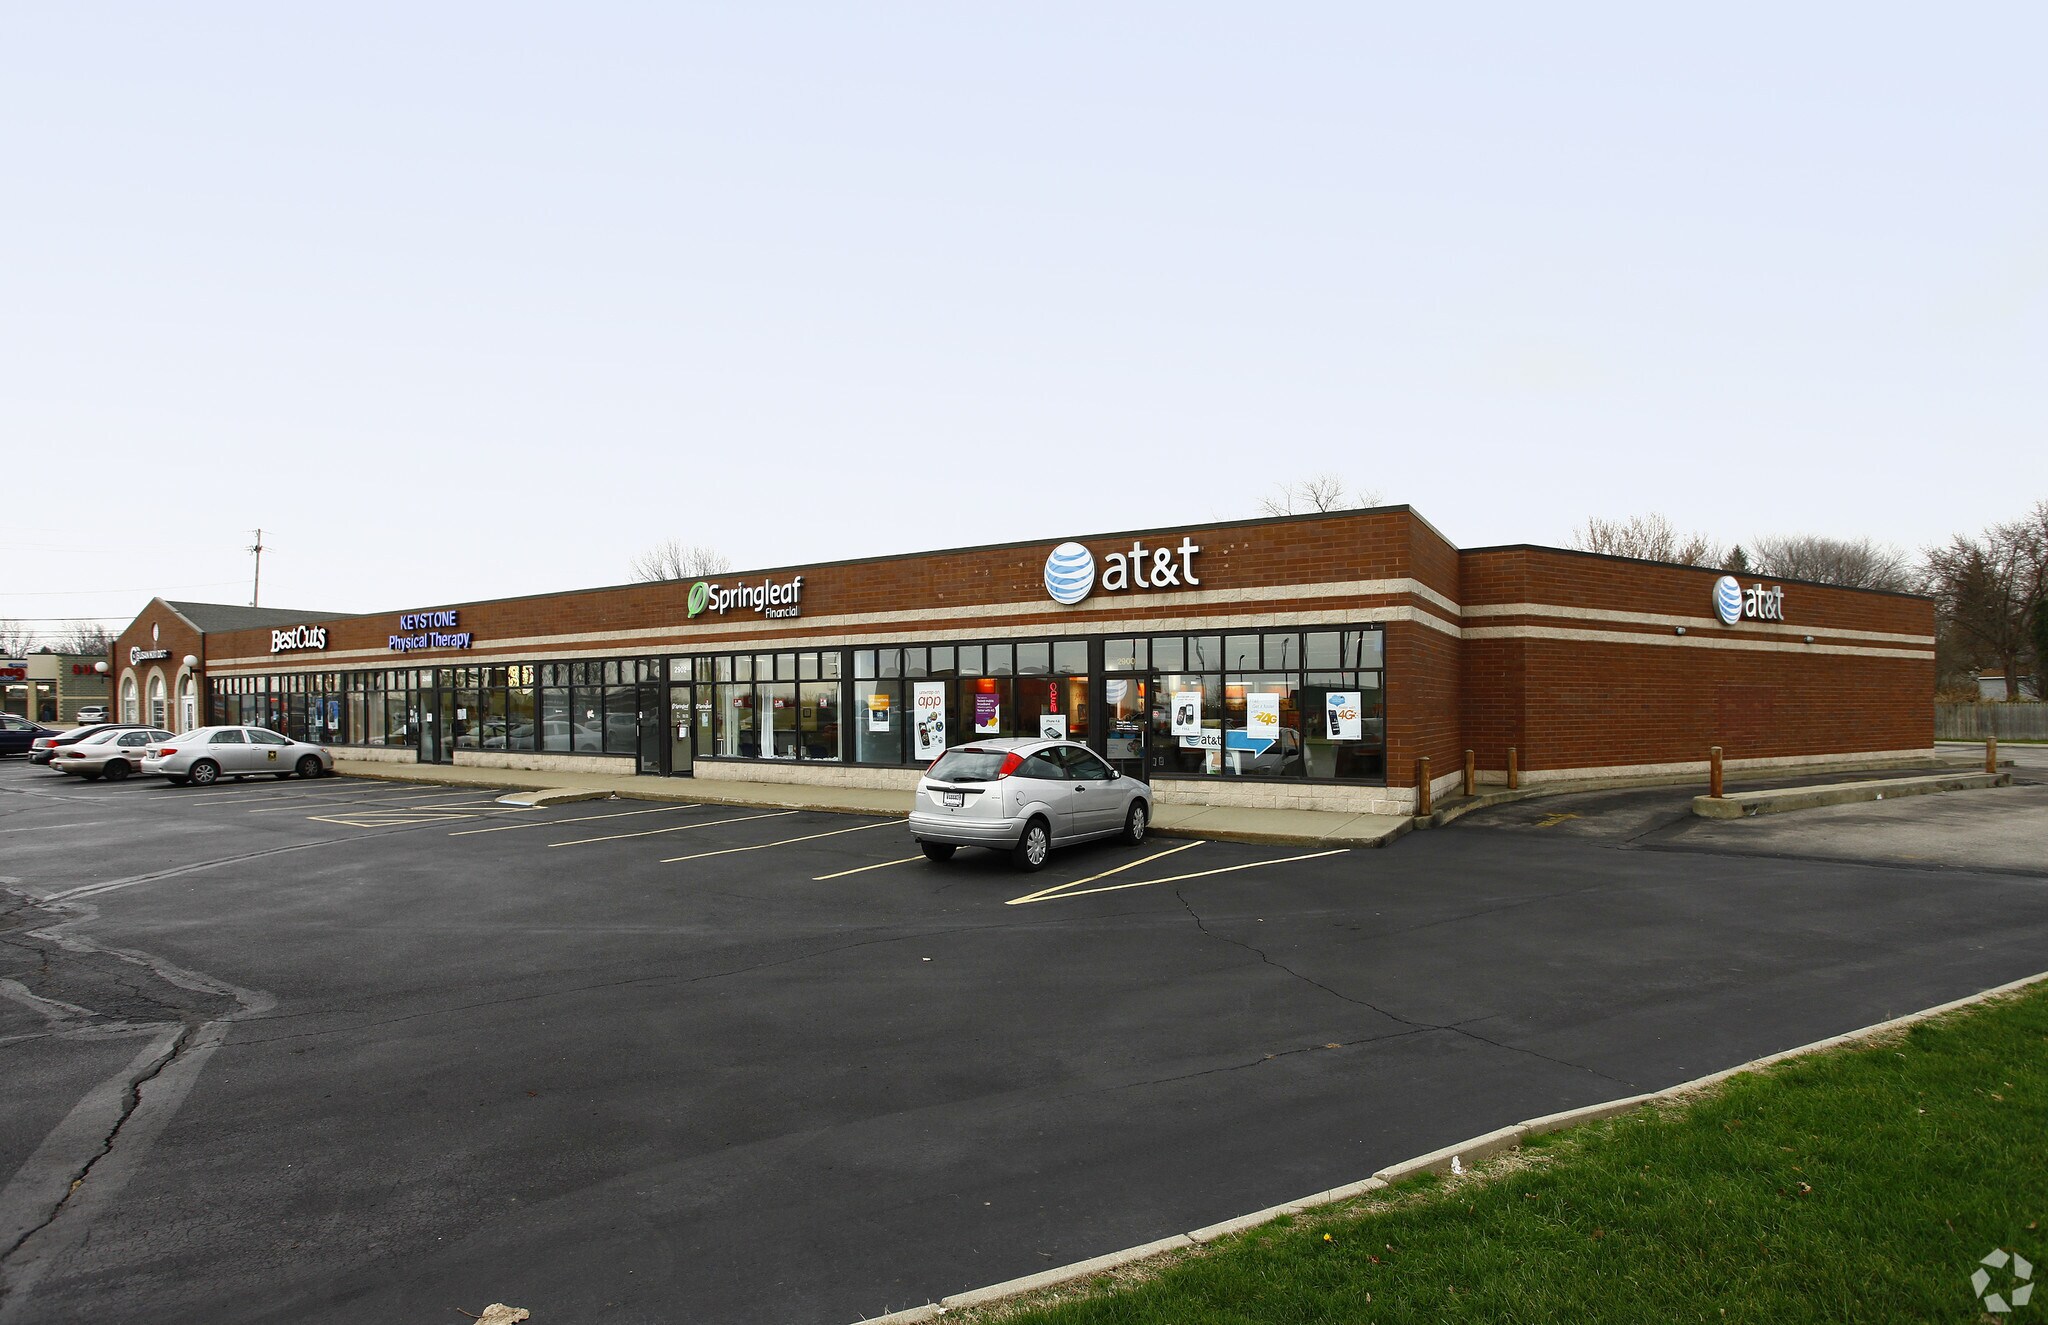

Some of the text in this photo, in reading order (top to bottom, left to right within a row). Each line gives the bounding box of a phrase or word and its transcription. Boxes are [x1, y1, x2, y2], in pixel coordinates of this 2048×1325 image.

[1102, 537, 1199, 591] at&t
[709, 576, 801, 615] Springleaf
[1745, 584, 1785, 621] at&t
[400, 610, 457, 630] KEYSTONE
[765, 606, 798, 619] Financial
[388, 632, 470, 652] Physical Therapy
[1117, 657, 1136, 666] 2900
[917, 696, 942, 710] app
[1261, 712, 1278, 726] 4G
[1338, 709, 1355, 720] 4G
